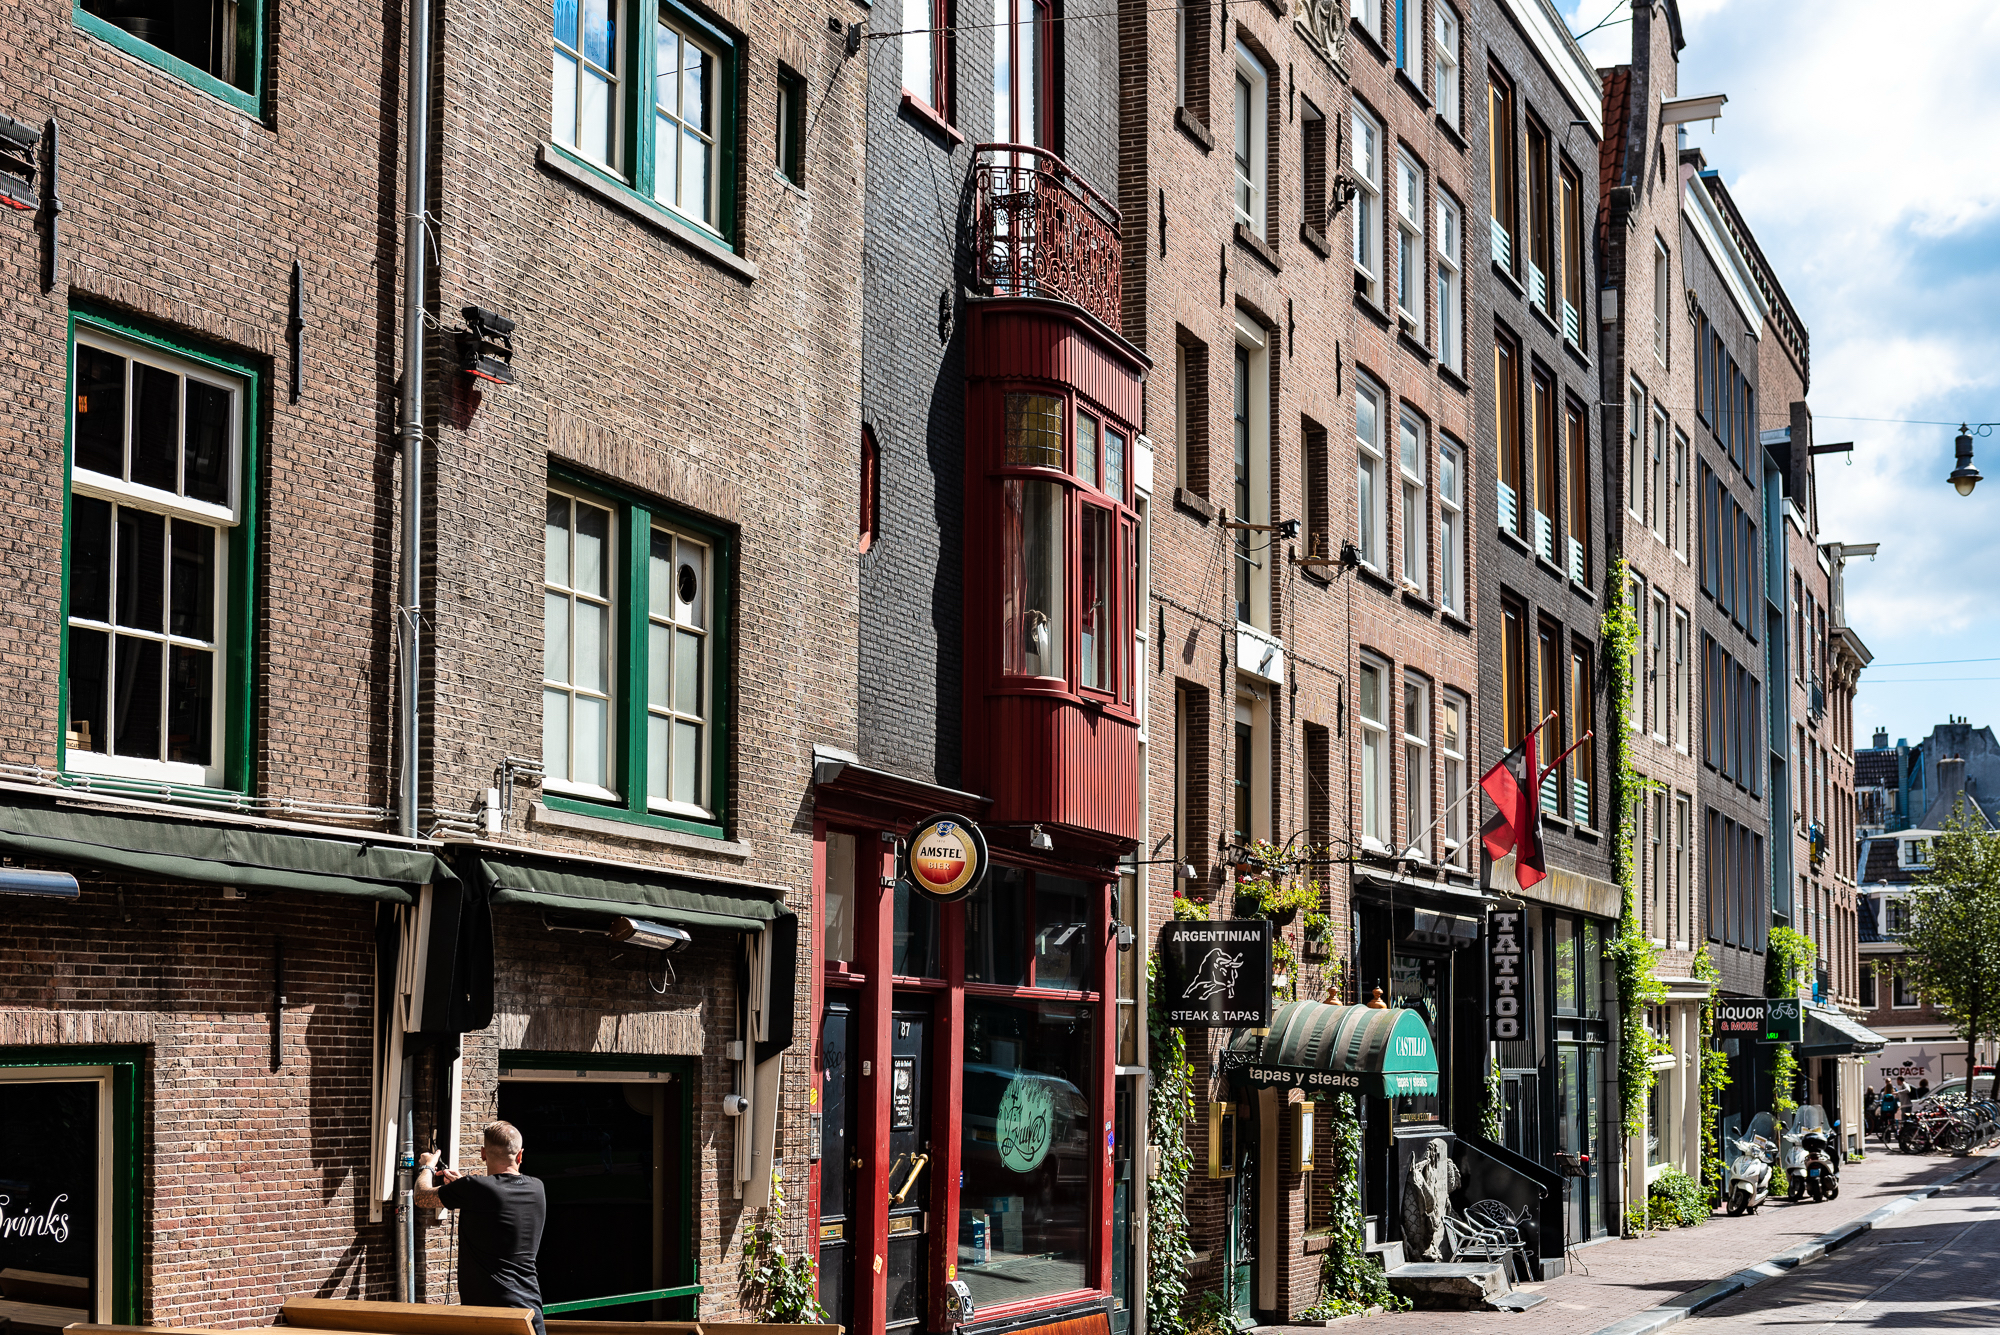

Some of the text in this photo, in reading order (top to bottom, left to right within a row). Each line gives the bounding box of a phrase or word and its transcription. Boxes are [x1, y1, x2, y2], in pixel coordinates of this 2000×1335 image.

[920, 847, 962, 858] AMSTEL
[928, 862, 951, 870] BIER
[1173, 931, 1261, 941] ARGENTINIAN
[1492, 913, 1521, 1038] TATTOO
[1171, 1011, 1260, 1021] STEAK & TAPAS
[1716, 1006, 1765, 1020] LIQUOR
[901, 1021, 911, 1037] 87
[1721, 1021, 1759, 1031] & MORE
[1396, 1036, 1427, 1057] CASTILLO
[1249, 1067, 1360, 1087] tapas y steaks
[1396, 1075, 1428, 1090] tapas y steaks
